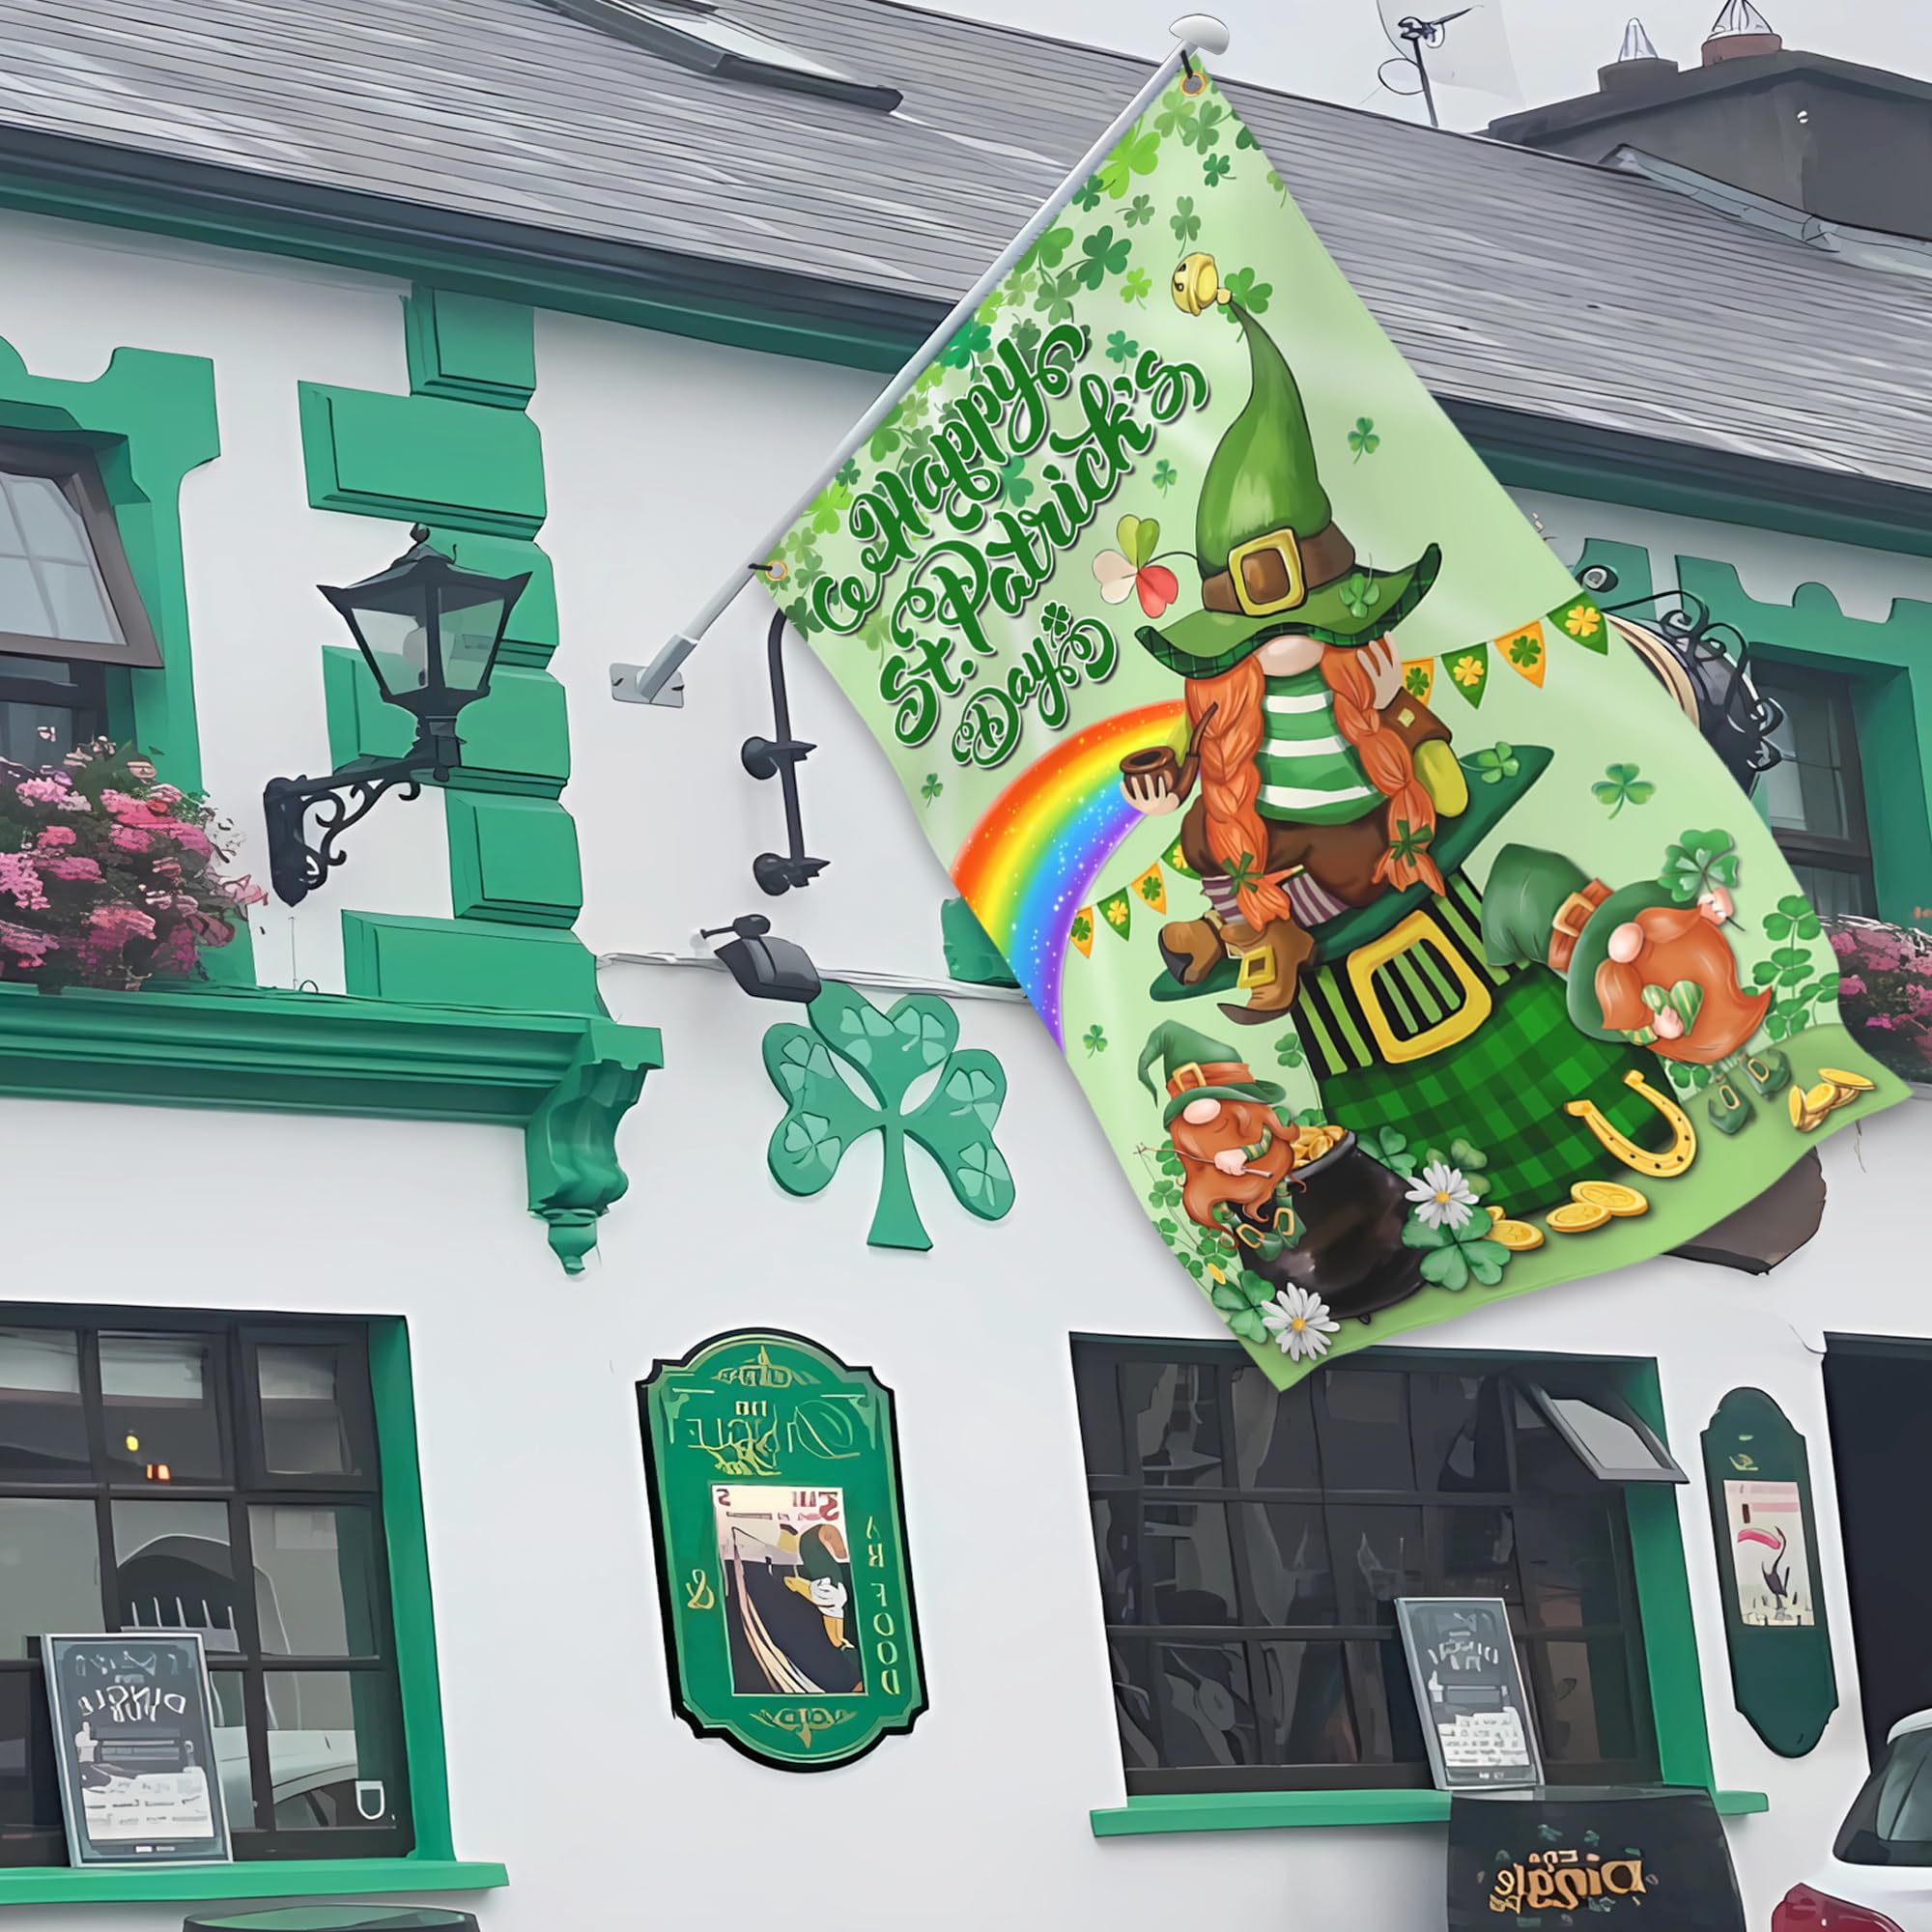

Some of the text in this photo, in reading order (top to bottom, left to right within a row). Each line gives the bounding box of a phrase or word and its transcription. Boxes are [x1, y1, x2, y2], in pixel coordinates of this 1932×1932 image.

[812, 325, 1087, 633] Happy
[879, 350, 1208, 745] St. Patrick's
[952, 616, 1116, 766] Day
